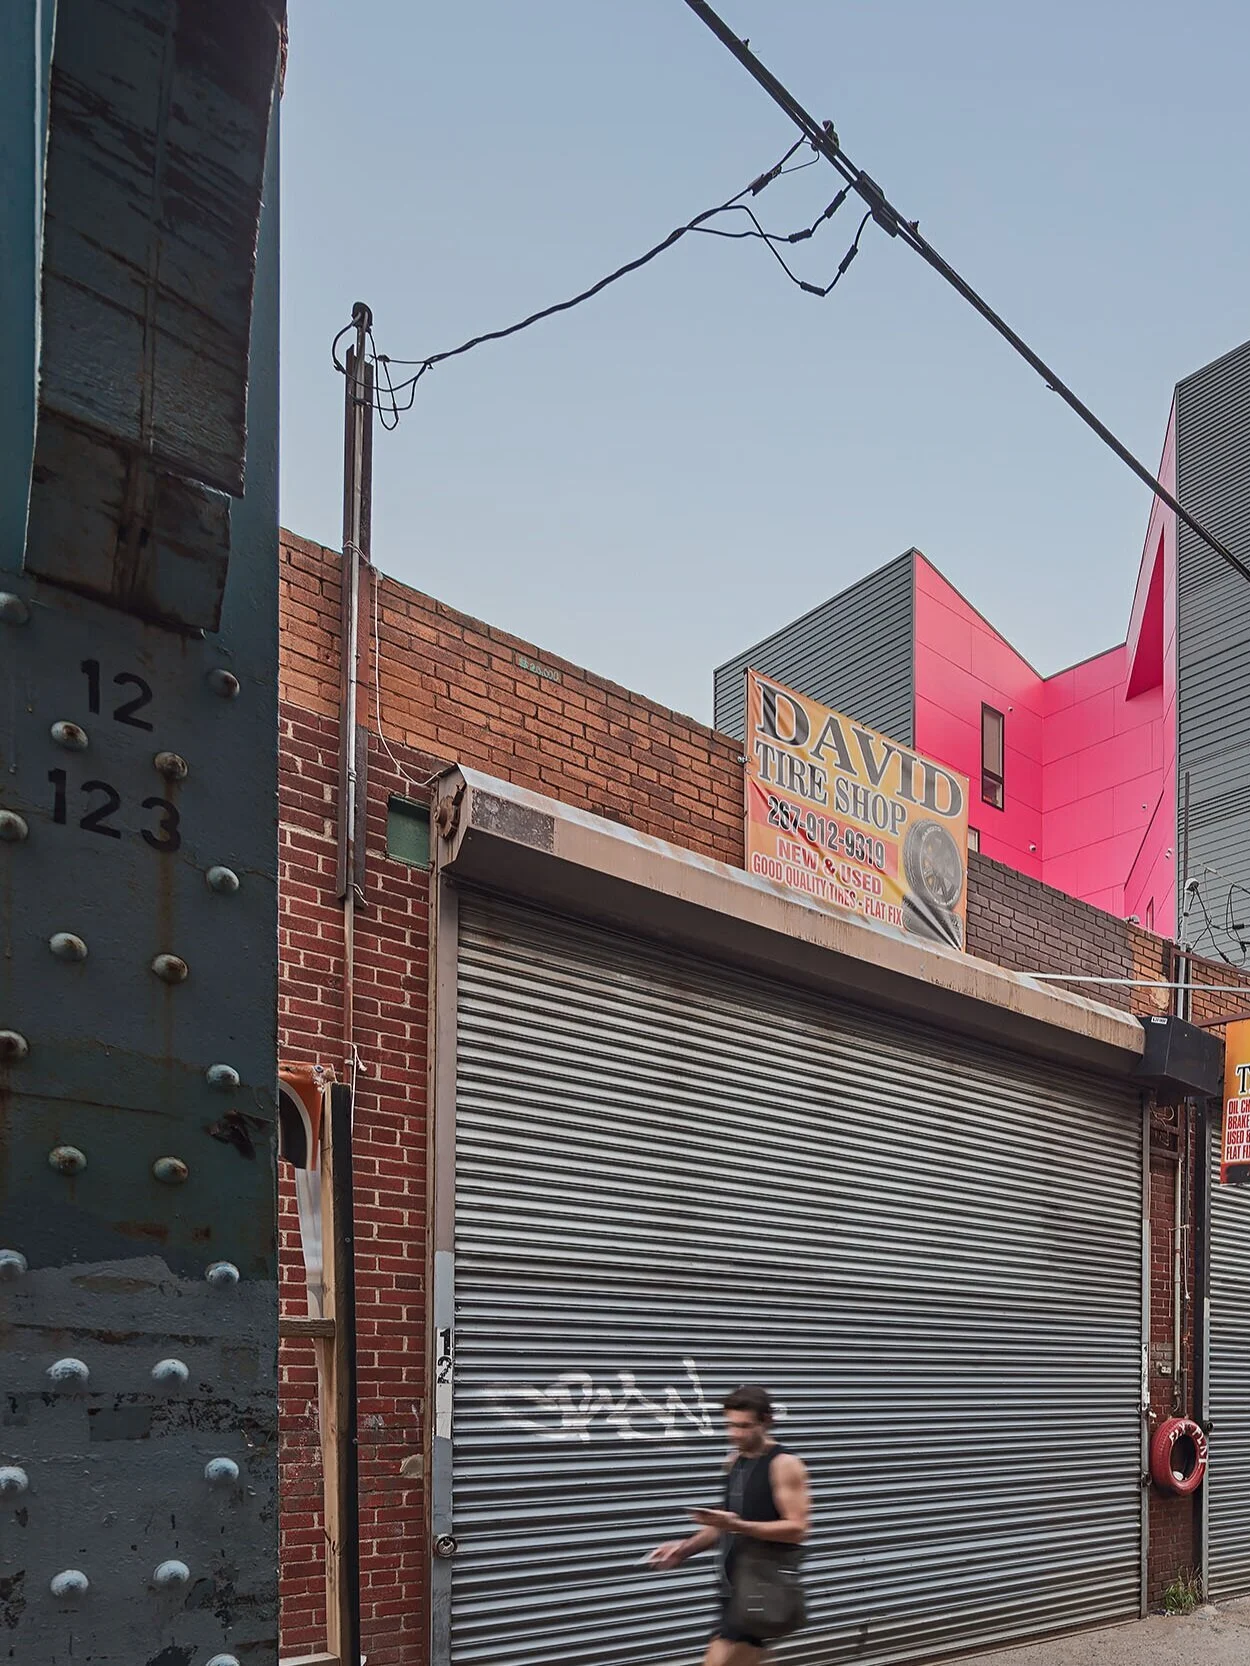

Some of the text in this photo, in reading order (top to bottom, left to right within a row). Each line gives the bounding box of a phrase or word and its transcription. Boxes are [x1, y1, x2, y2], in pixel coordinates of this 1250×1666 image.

[80, 659, 153, 732] 12
[755, 679, 963, 817] DAVID
[48, 767, 181, 851] 123
[755, 740, 907, 836] TIRE SHOP
[768, 795, 885, 869] 267-912-9319
[778, 838, 882, 895] NEW & USED
[753, 853, 782, 881] GOOD
[786, 867, 826, 896] QUALITY
[829, 882, 856, 909] TIRES
[865, 897, 885, 921] FLAT
[888, 906, 902, 926] FIX
[1227, 1130, 1244, 1145] USED
[1228, 1100, 1239, 1115] OIL
[1228, 1114, 1250, 1130] BRAKE
[1226, 1145, 1241, 1160] FLAT
